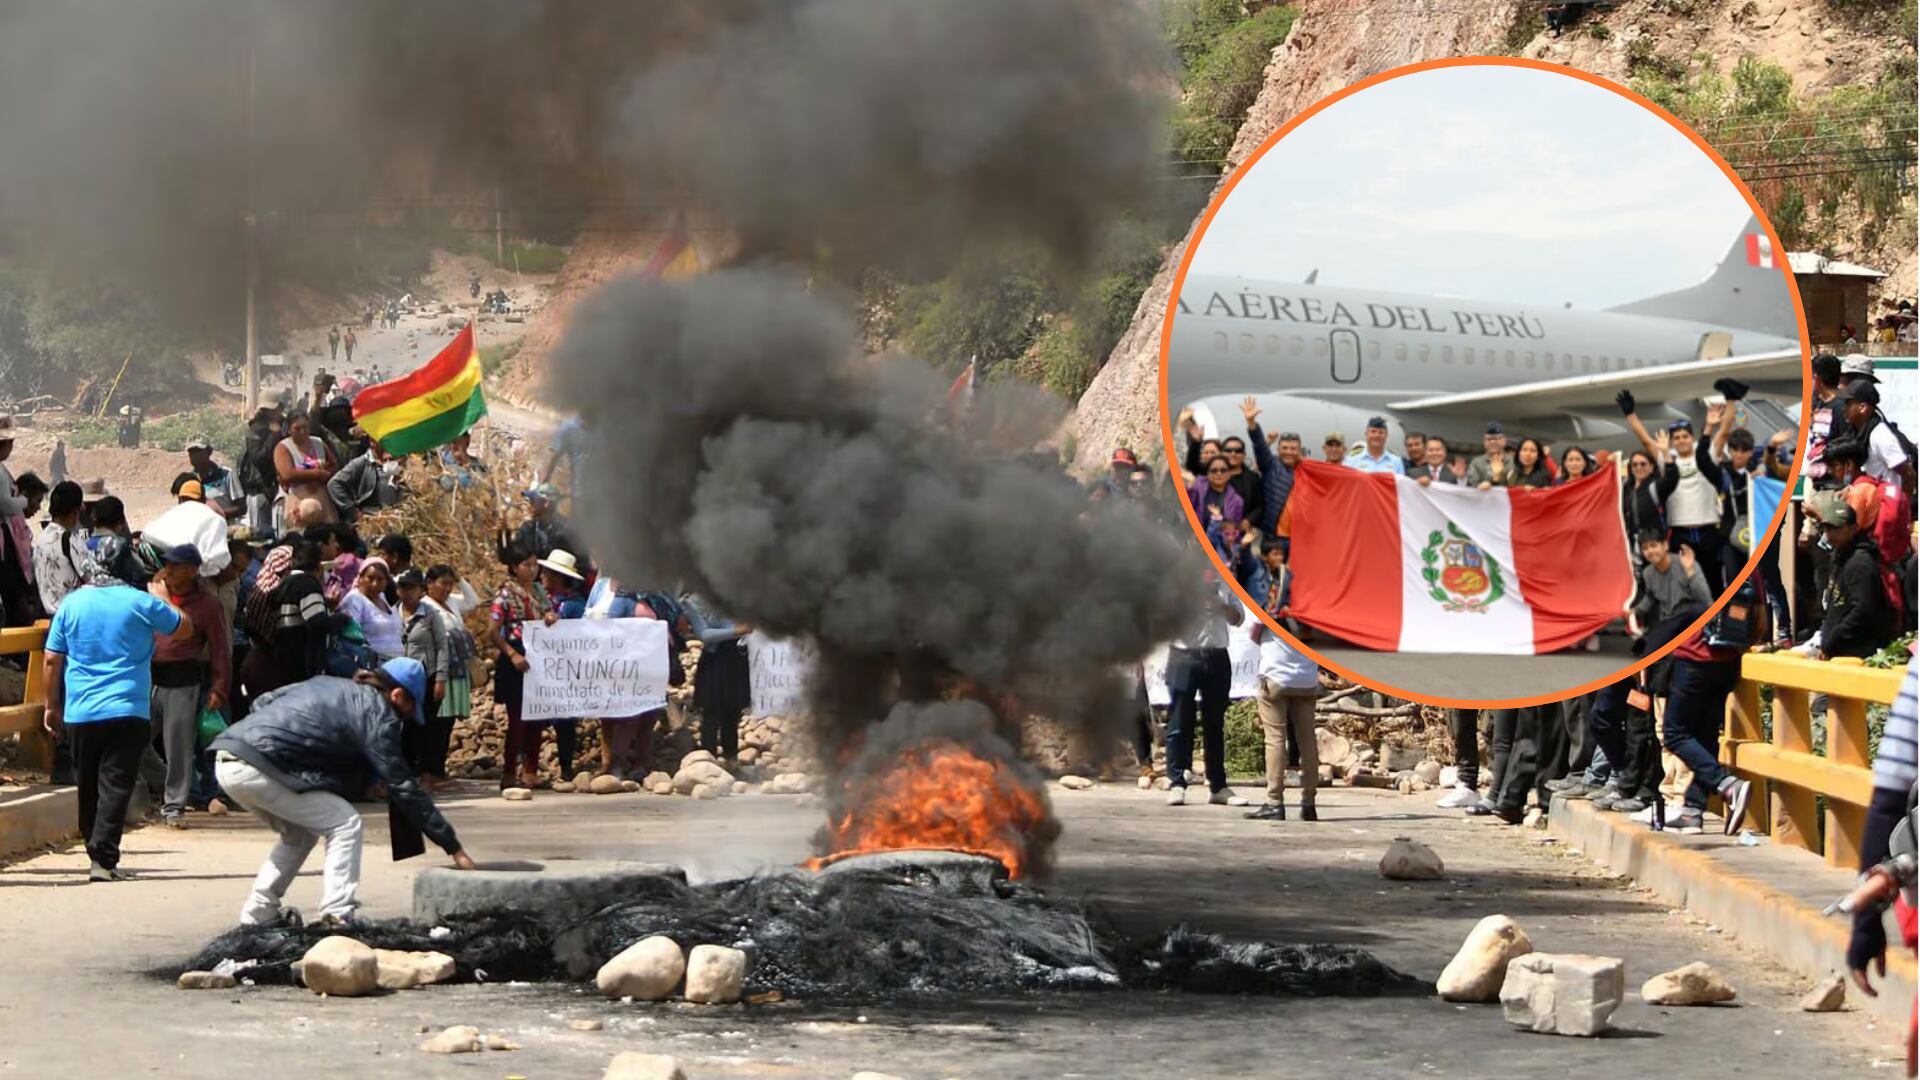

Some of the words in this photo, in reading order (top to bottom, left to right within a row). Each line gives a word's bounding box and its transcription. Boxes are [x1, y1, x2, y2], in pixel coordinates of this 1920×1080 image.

[1203, 287, 1359, 327] AÉREA
[1366, 302, 1447, 333] DEL
[1452, 310, 1546, 340] PERÚ
[610, 635, 625, 649] la
[543, 657, 640, 681] RENUNCIA
[609, 680, 625, 697] de
[632, 684, 652, 697] los
